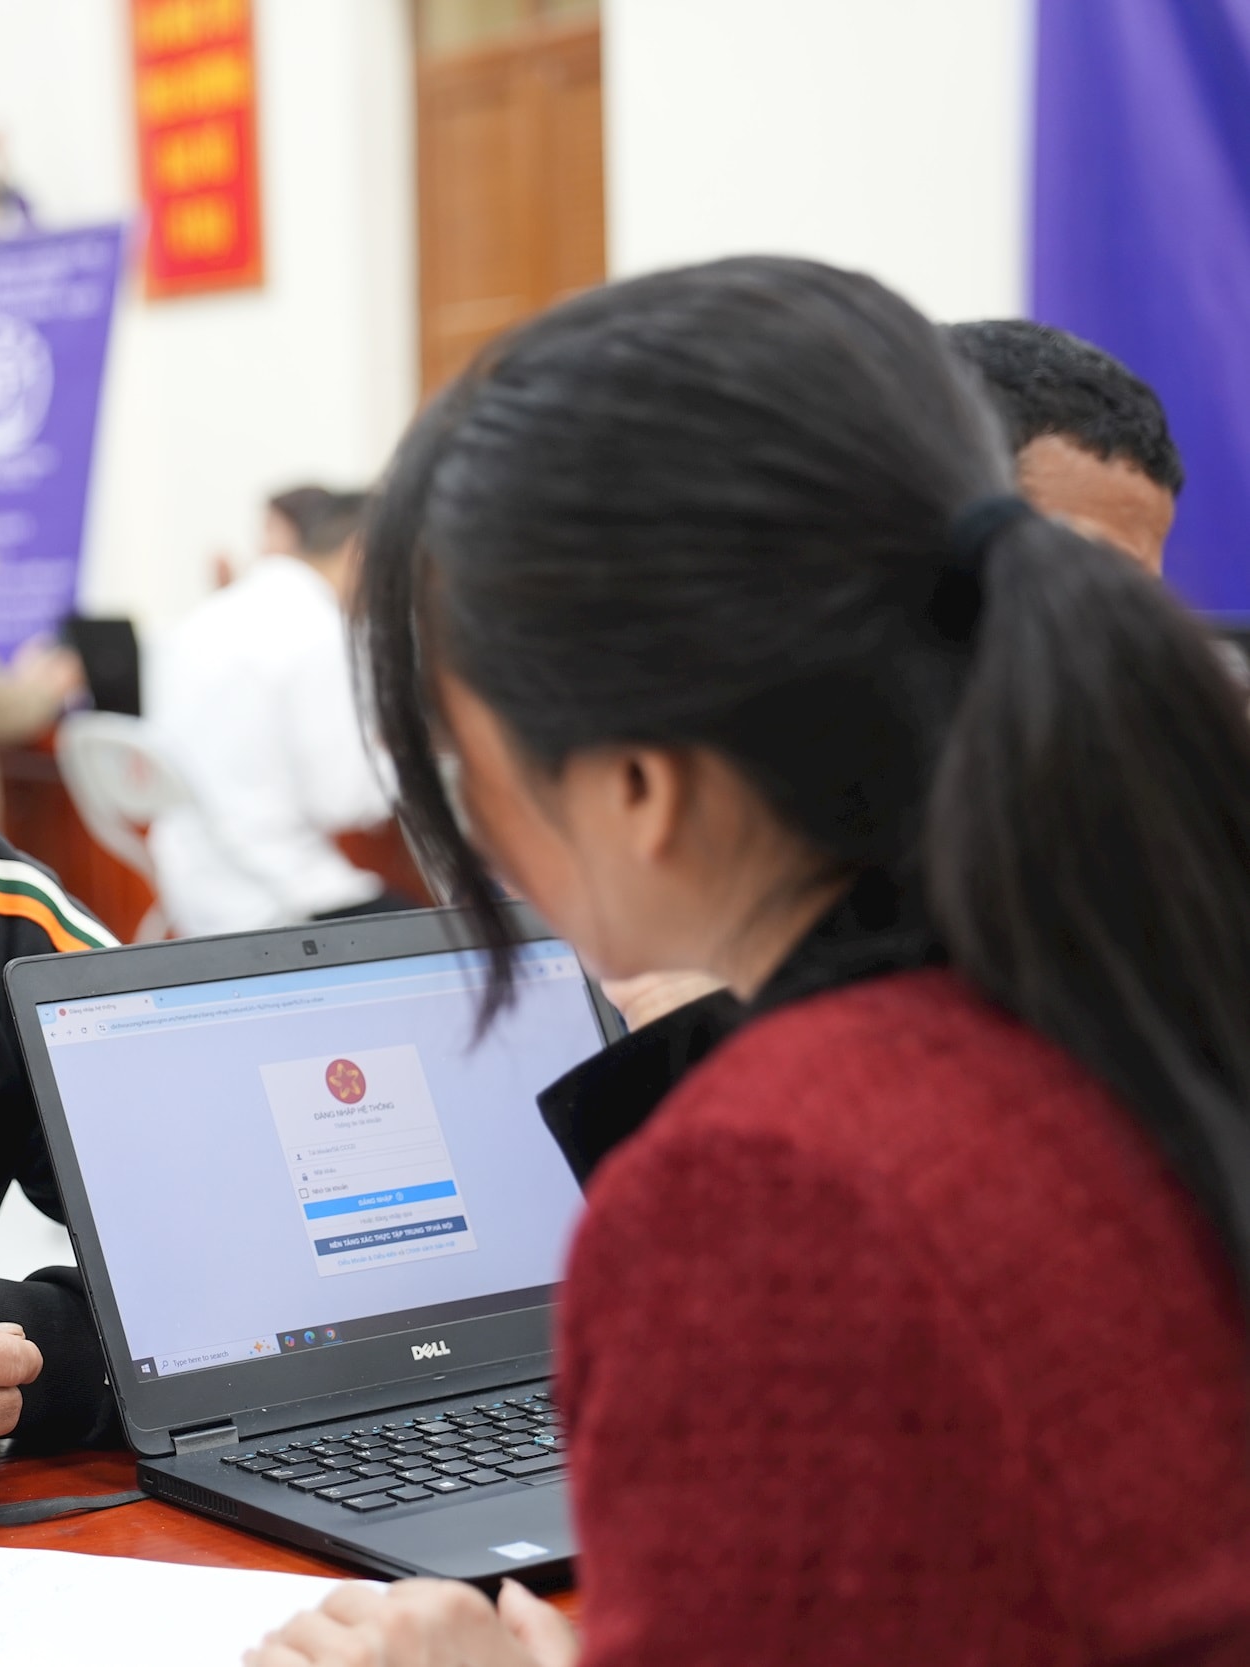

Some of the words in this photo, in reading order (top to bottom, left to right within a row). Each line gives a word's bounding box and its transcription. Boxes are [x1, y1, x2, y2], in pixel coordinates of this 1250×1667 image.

[173, 1359, 187, 1368] Type
[210, 1350, 229, 1359] search
[410, 1340, 451, 1360] DELL
